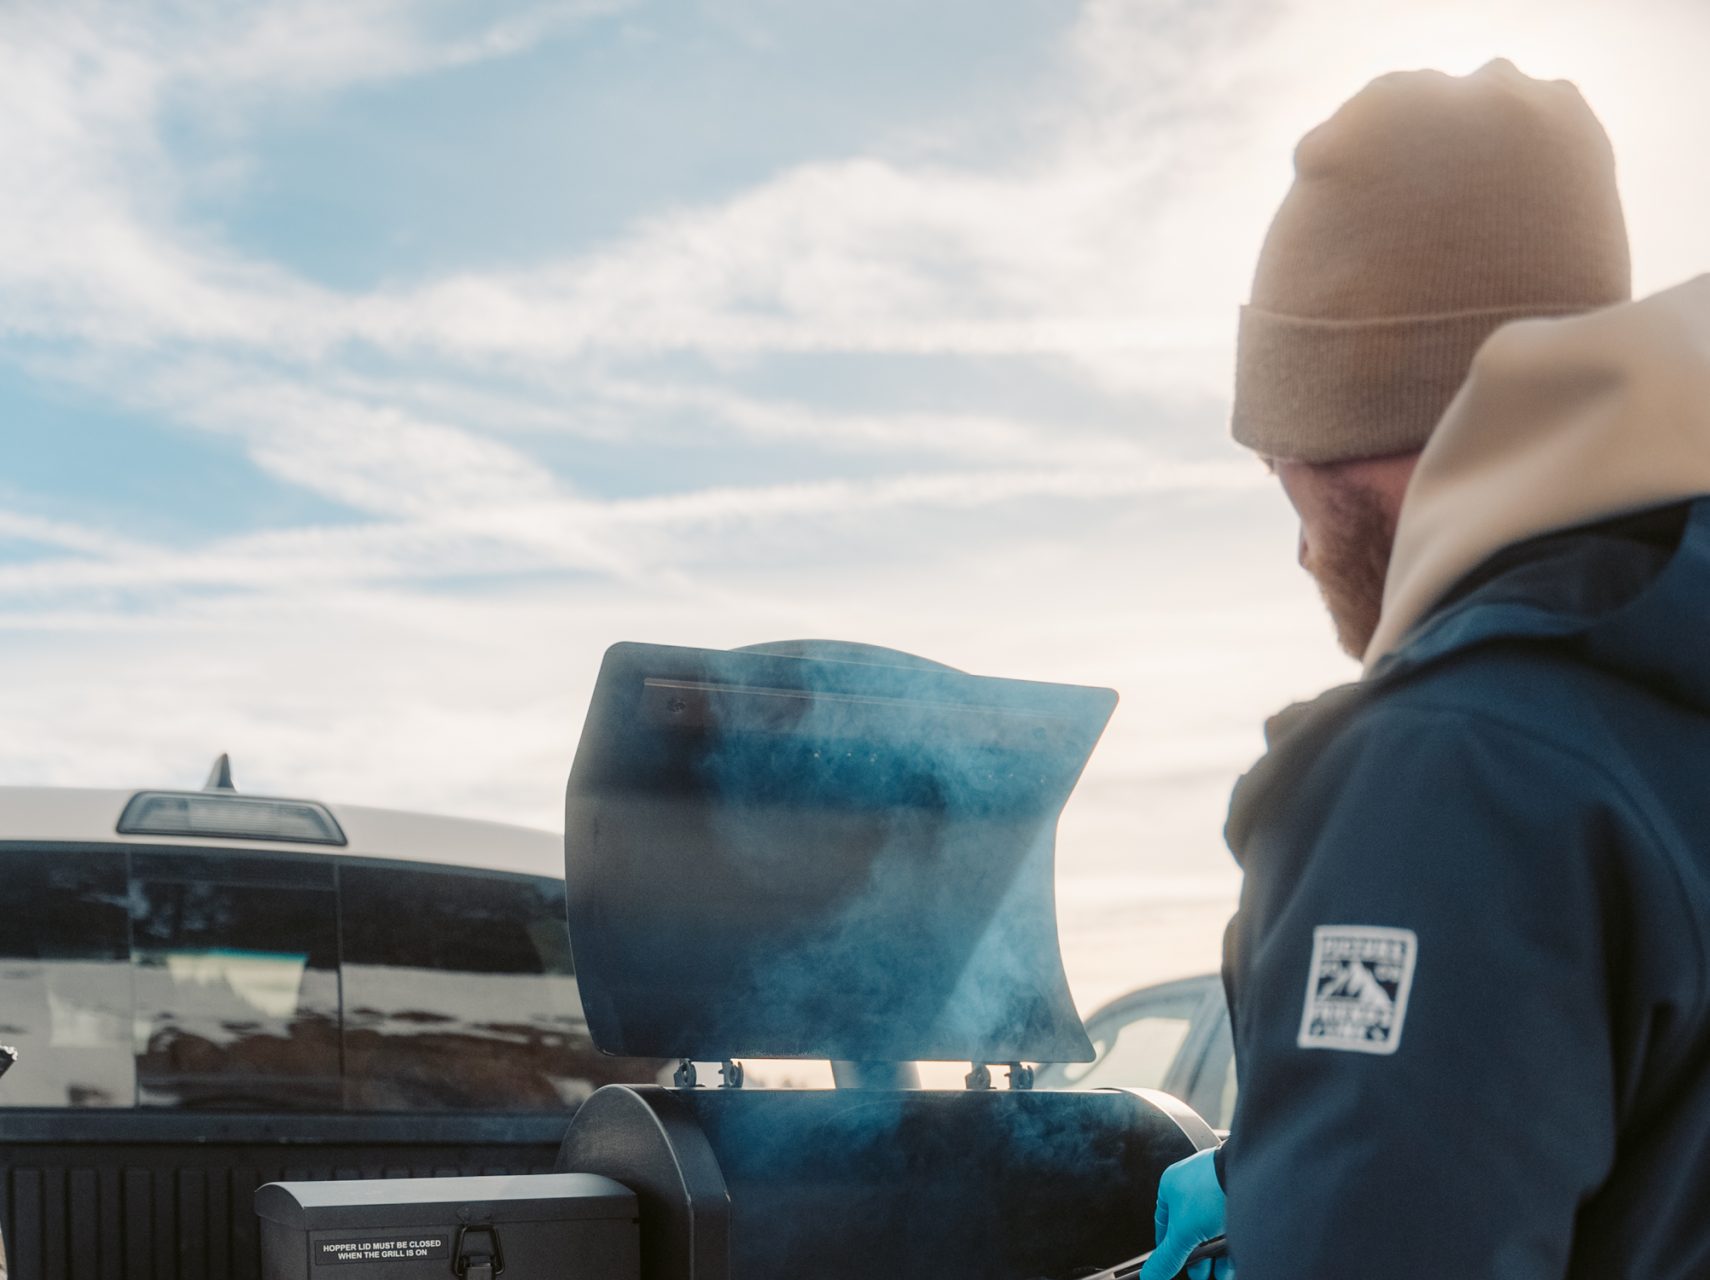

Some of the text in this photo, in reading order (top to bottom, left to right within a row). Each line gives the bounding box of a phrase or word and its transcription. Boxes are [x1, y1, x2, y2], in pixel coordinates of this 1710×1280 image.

[323, 1244, 357, 1252] HOPPER
[358, 1242, 371, 1250] LID
[373, 1241, 395, 1250] MUST
[409, 1240, 442, 1248] CLOSED
[338, 1252, 362, 1260] WHEN
[364, 1251, 380, 1259] THE
[381, 1250, 405, 1258] GRILL
[406, 1249, 414, 1257] IS
